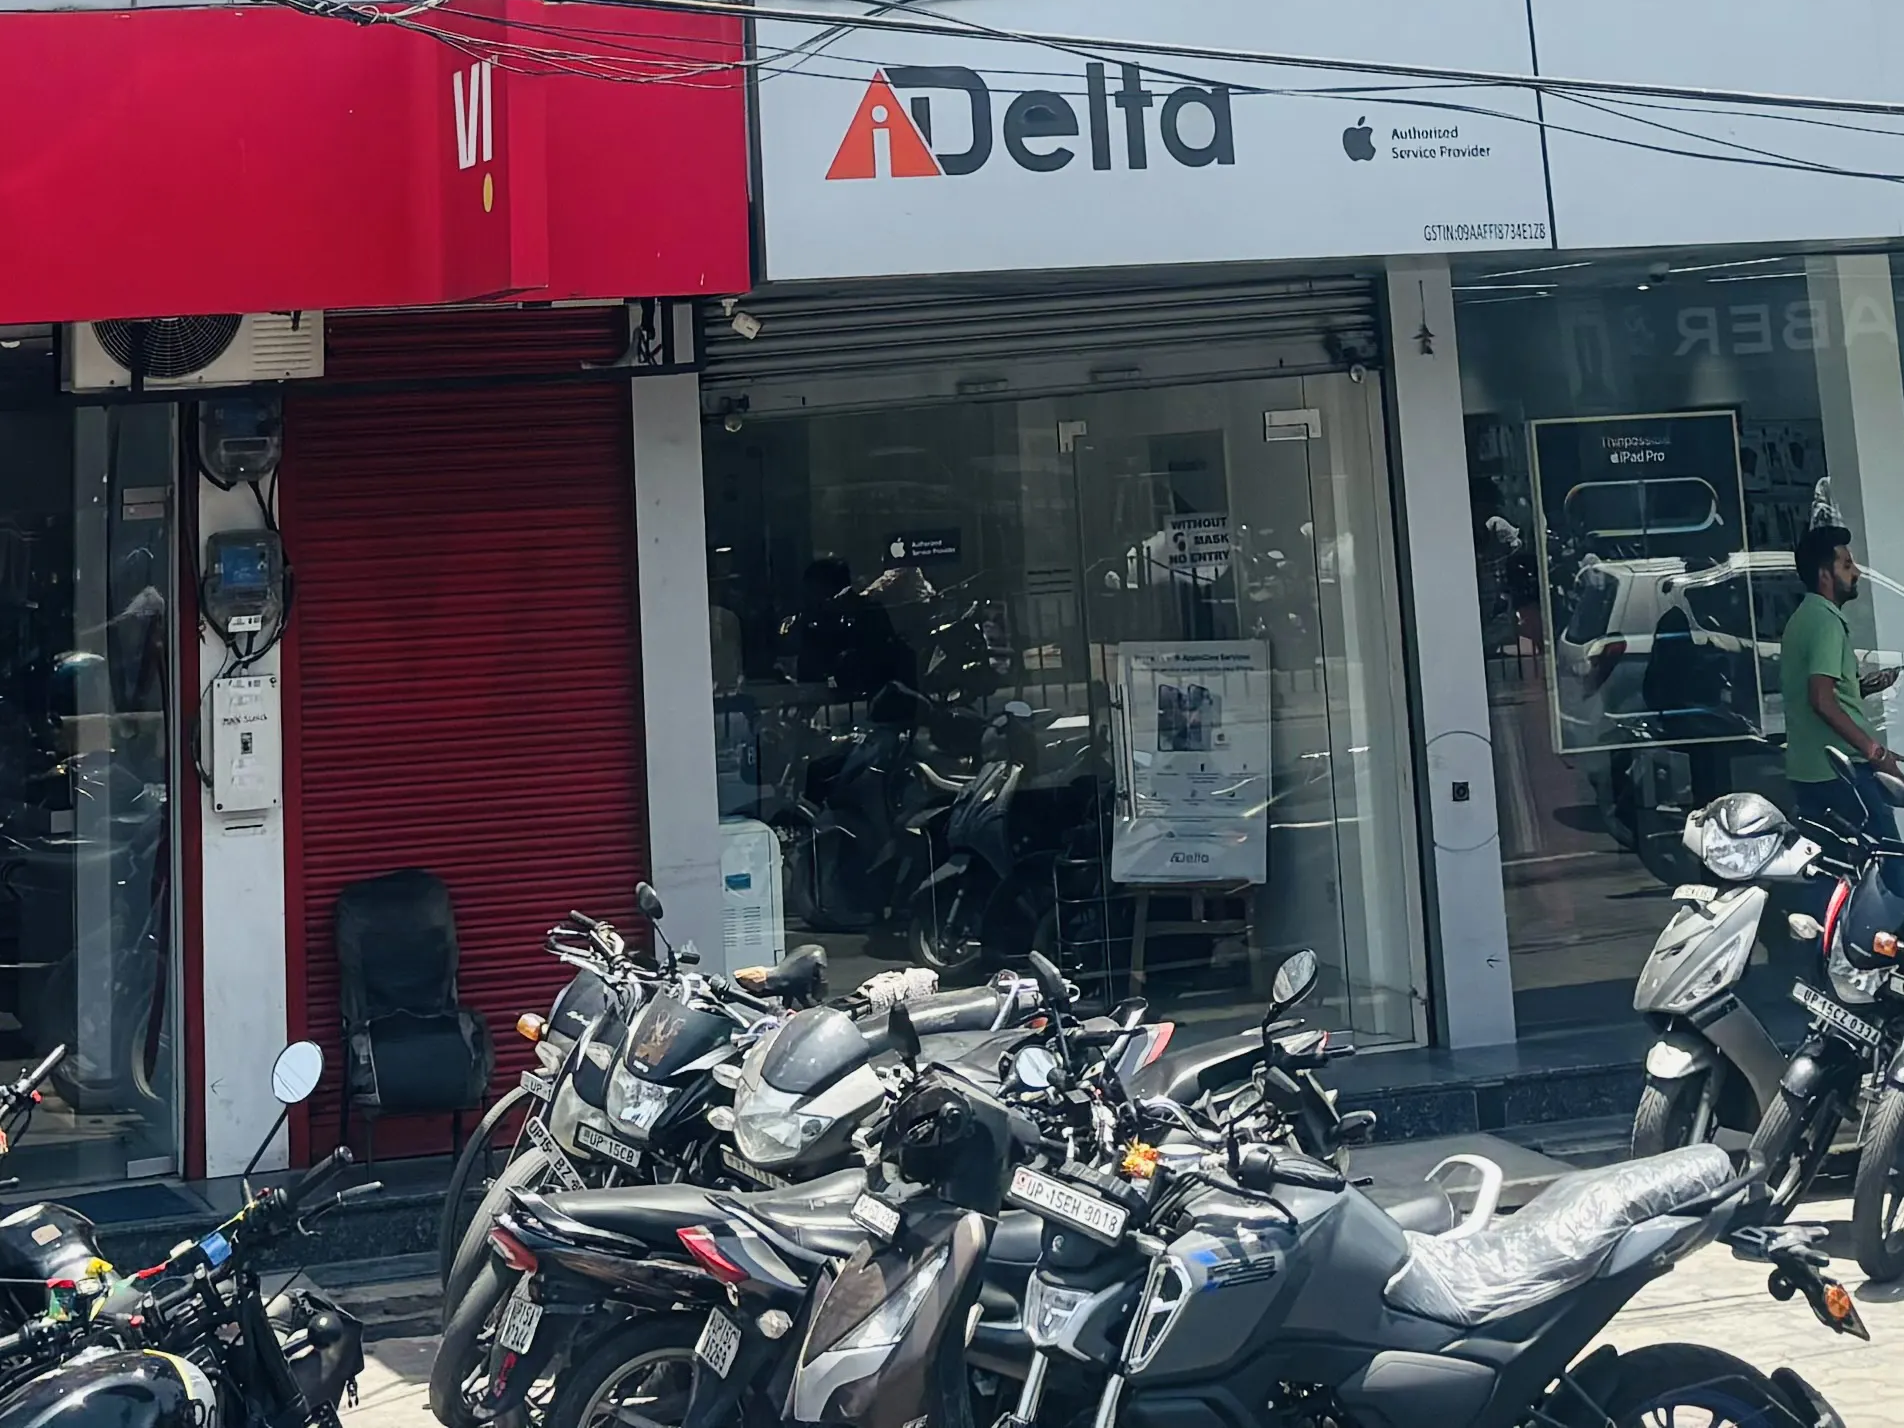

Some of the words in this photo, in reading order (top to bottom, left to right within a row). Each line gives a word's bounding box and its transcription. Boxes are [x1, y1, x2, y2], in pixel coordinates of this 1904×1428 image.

[1391, 145, 1437, 163] Service
[1440, 143, 1492, 161] Provider
[1646, 449, 1666, 463] Pro
[1170, 517, 1228, 531] WITHOUT
[1190, 550, 1231, 564] ENTRY
[1802, 989, 1820, 1005] UP
[529, 1080, 543, 1094] UP
[589, 1131, 604, 1147] UP
[1026, 1179, 1043, 1201] UP
